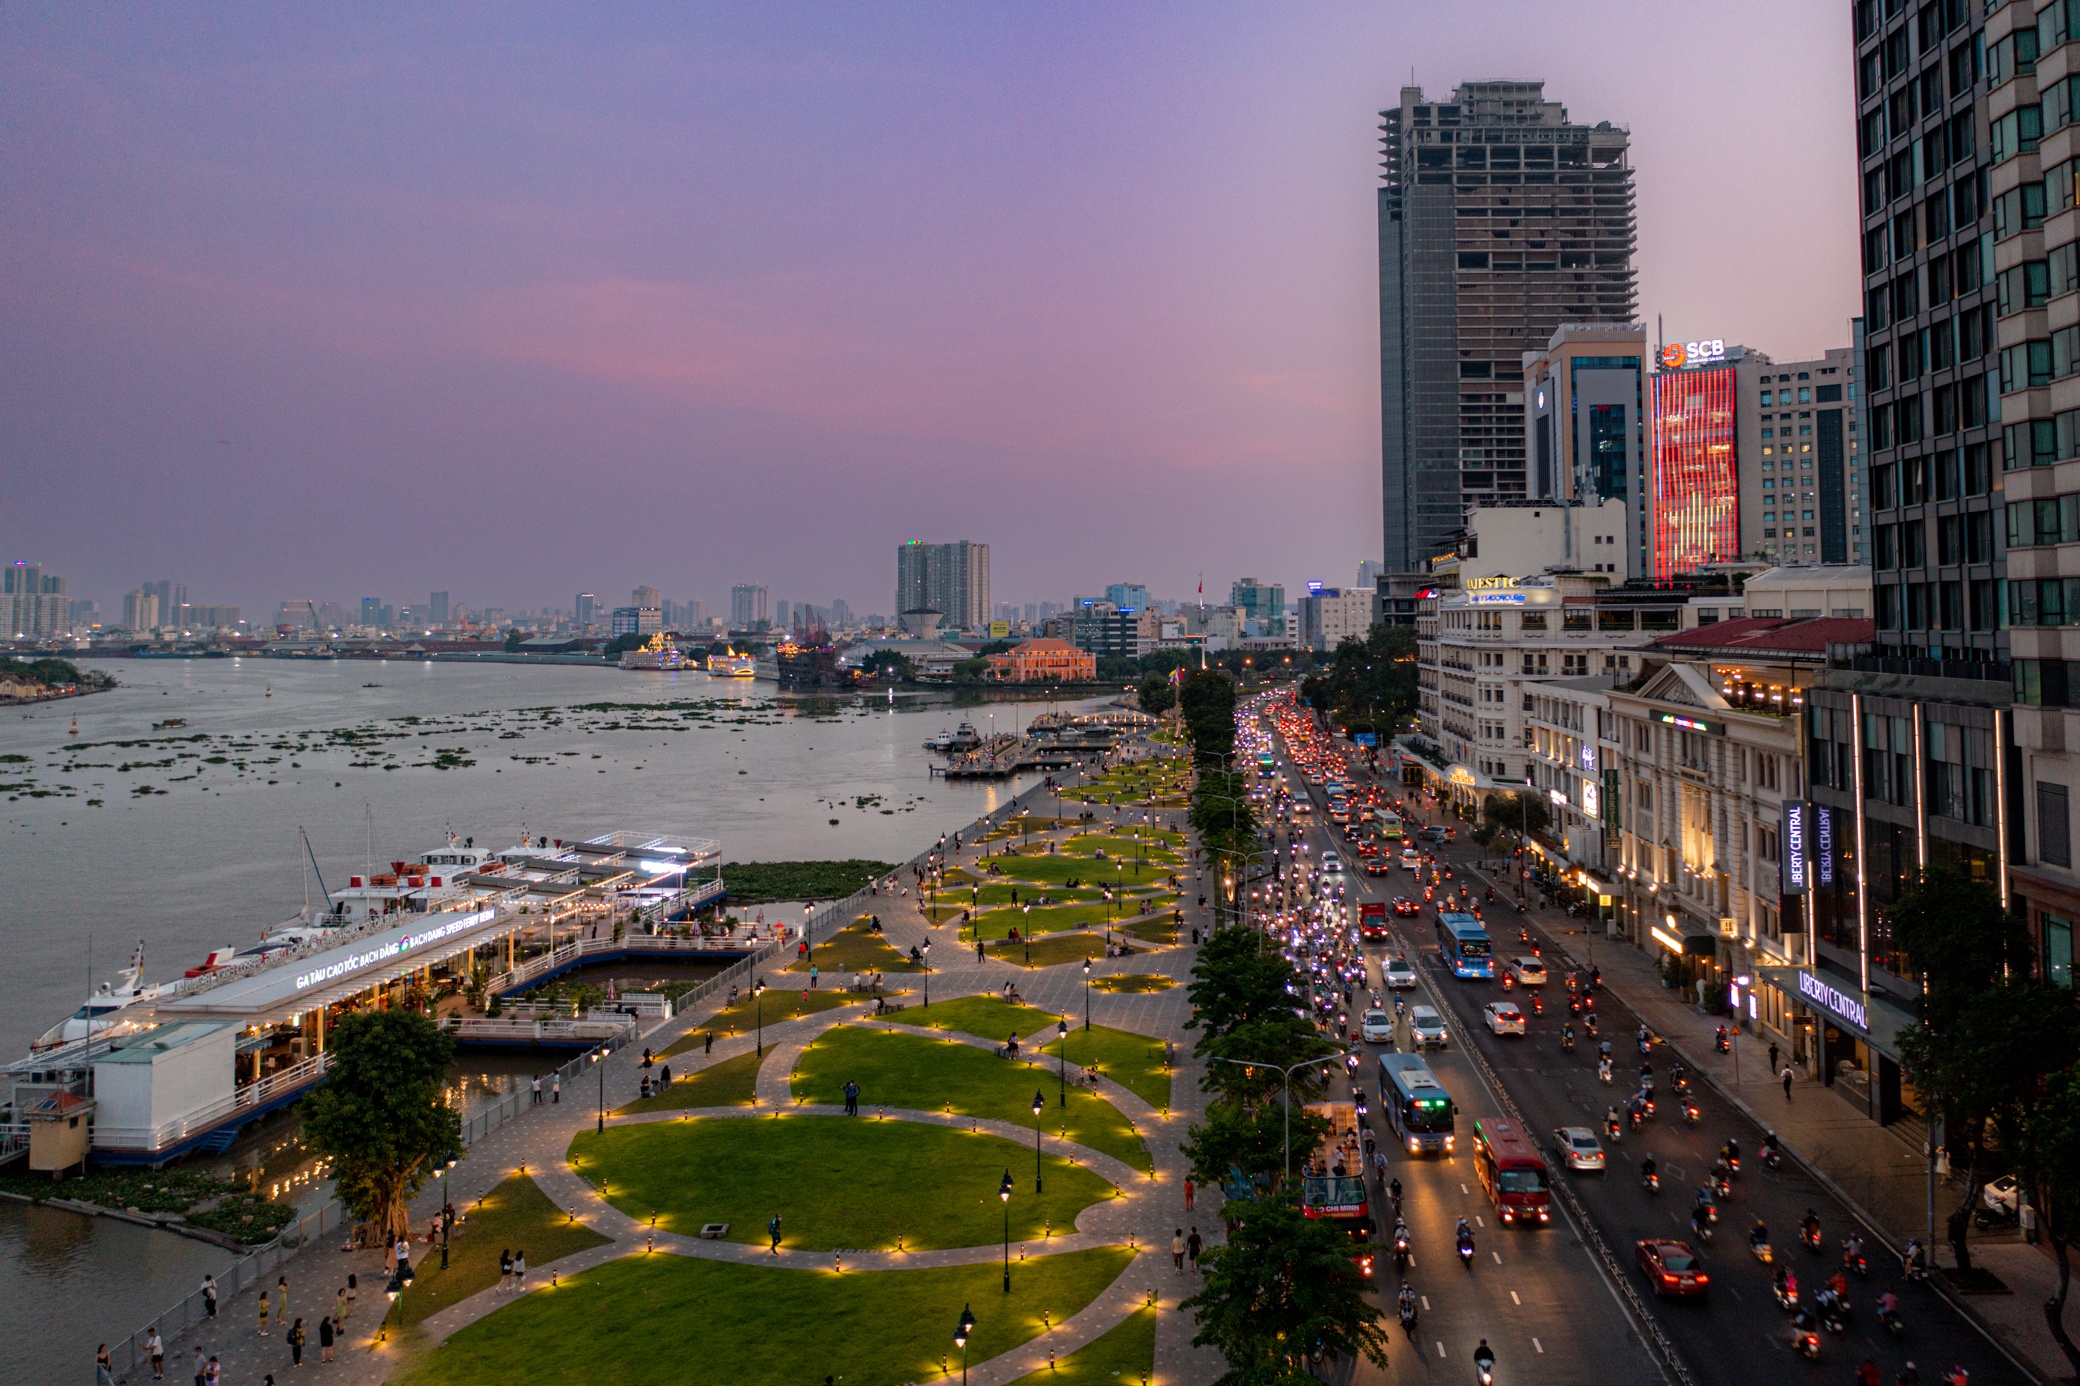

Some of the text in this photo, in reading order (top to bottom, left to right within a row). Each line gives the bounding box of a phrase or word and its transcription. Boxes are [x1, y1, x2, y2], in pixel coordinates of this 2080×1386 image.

[1687, 340, 1724, 358] SCB
[1608, 771, 1616, 836] RIVERSIDE
[1789, 806, 1801, 850] CENTRAL
[297, 976, 309, 989] GA
[310, 967, 325, 984] TÀU
[327, 962, 343, 978] CAO
[360, 951, 379, 967] BẠCH
[410, 935, 427, 948] BACH
[428, 927, 445, 942] DANG
[446, 920, 463, 935] SPEED
[1799, 970, 1868, 1030] LIBERTY CENTRAL
[1340, 1204, 1359, 1212] MINH
